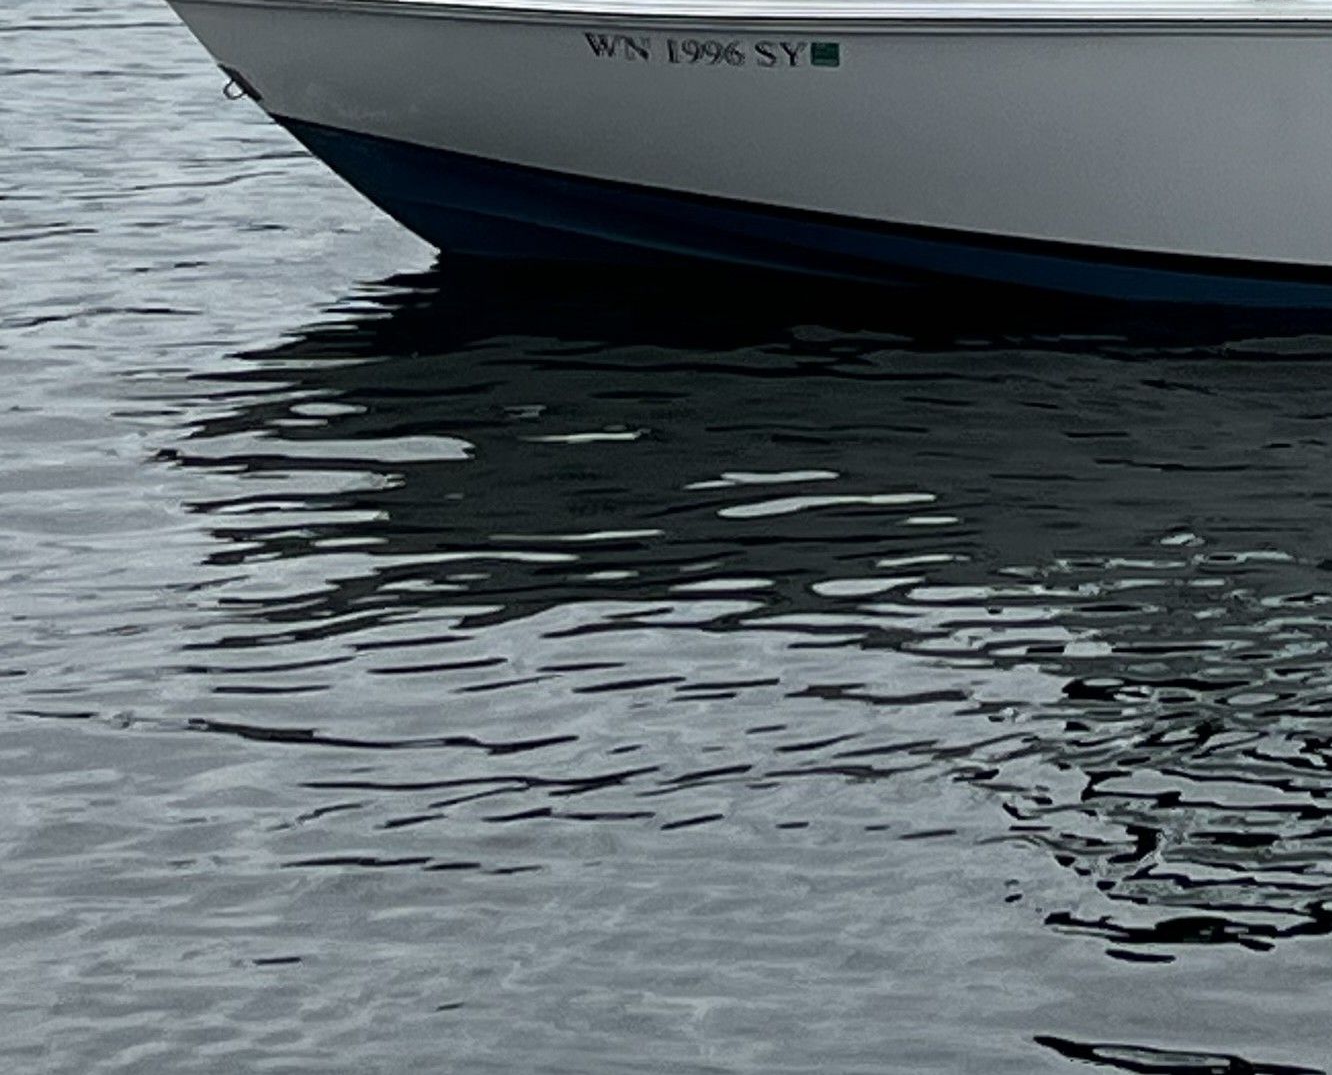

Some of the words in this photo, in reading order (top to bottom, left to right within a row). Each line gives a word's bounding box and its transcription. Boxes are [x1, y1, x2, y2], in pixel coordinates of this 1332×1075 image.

[585, 32, 650, 61] WN
[666, 39, 746, 66] 1996
[755, 39, 808, 67] SY
